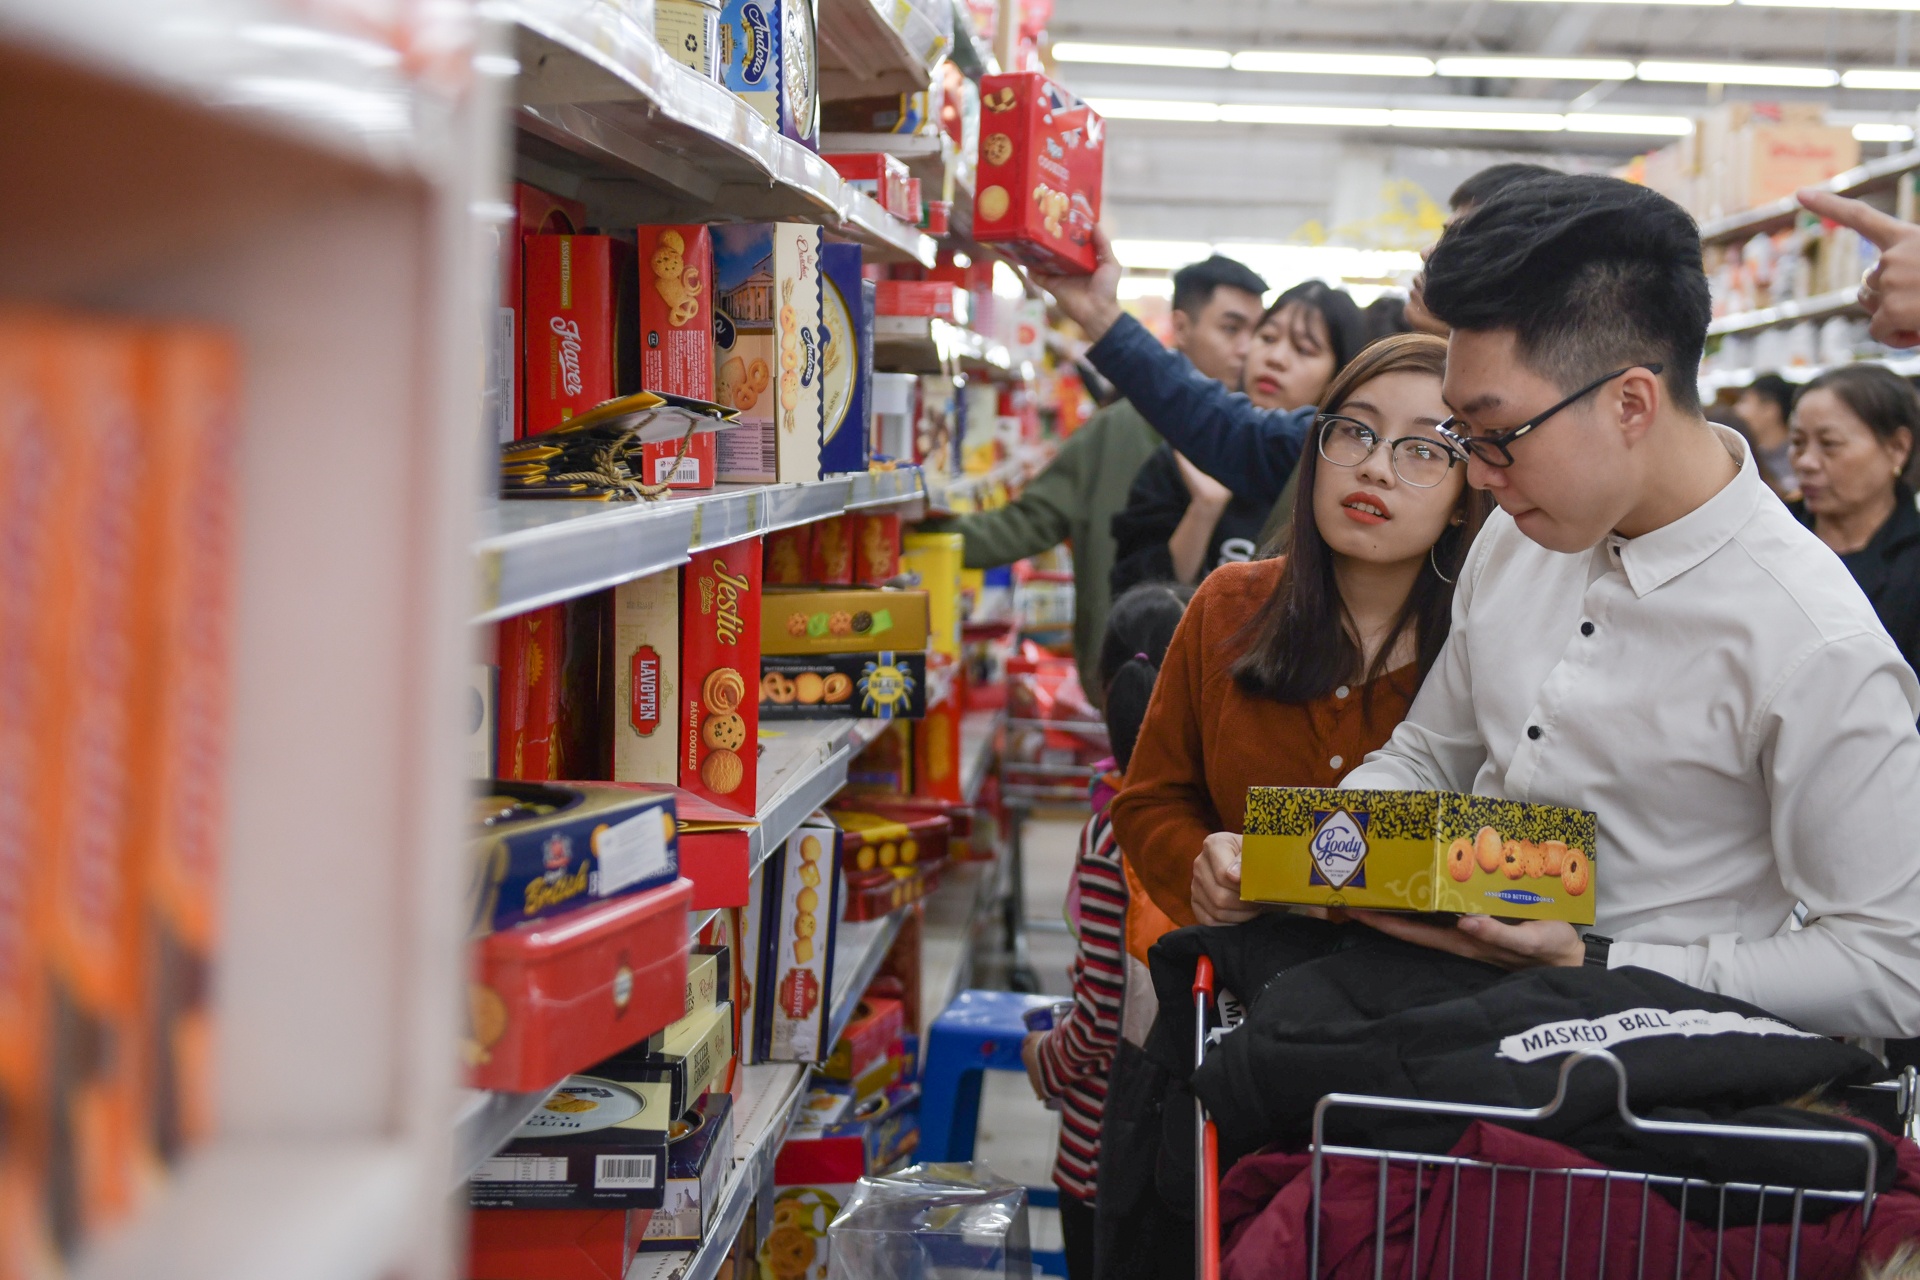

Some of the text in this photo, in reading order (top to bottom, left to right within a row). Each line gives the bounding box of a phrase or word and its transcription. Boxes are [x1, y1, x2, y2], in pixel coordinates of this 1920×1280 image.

[748, 8, 770, 75] Andora
[561, 240, 570, 281] ASSORTED
[802, 330, 816, 381] Andora
[713, 558, 750, 646] Jestic
[688, 730, 697, 771] COOKIES
[1316, 826, 1362, 867] Goody
[793, 969, 805, 1017] MAJESTIC
[1521, 1025, 1608, 1052] MASKED
[1618, 1012, 1671, 1031] BALL
